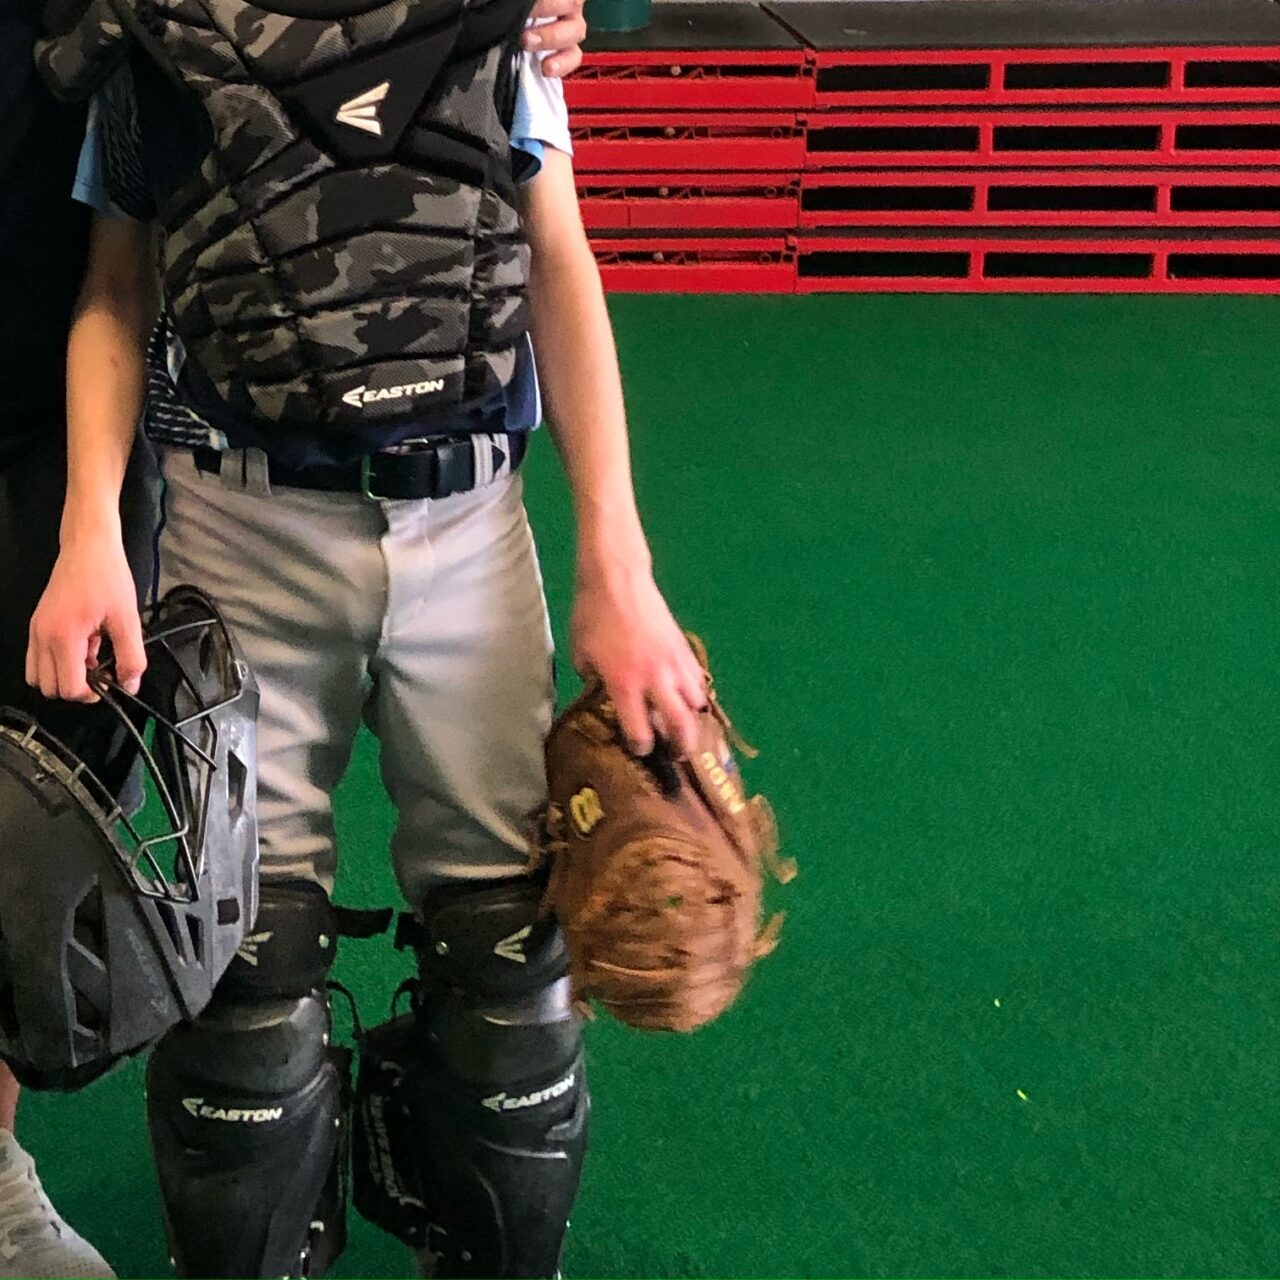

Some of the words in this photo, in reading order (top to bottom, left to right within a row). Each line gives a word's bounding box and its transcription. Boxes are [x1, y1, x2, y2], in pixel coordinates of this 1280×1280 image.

[363, 379, 444, 403] EASTON
[503, 1073, 575, 1109] EASTON
[200, 1105, 283, 1122] EASTON
